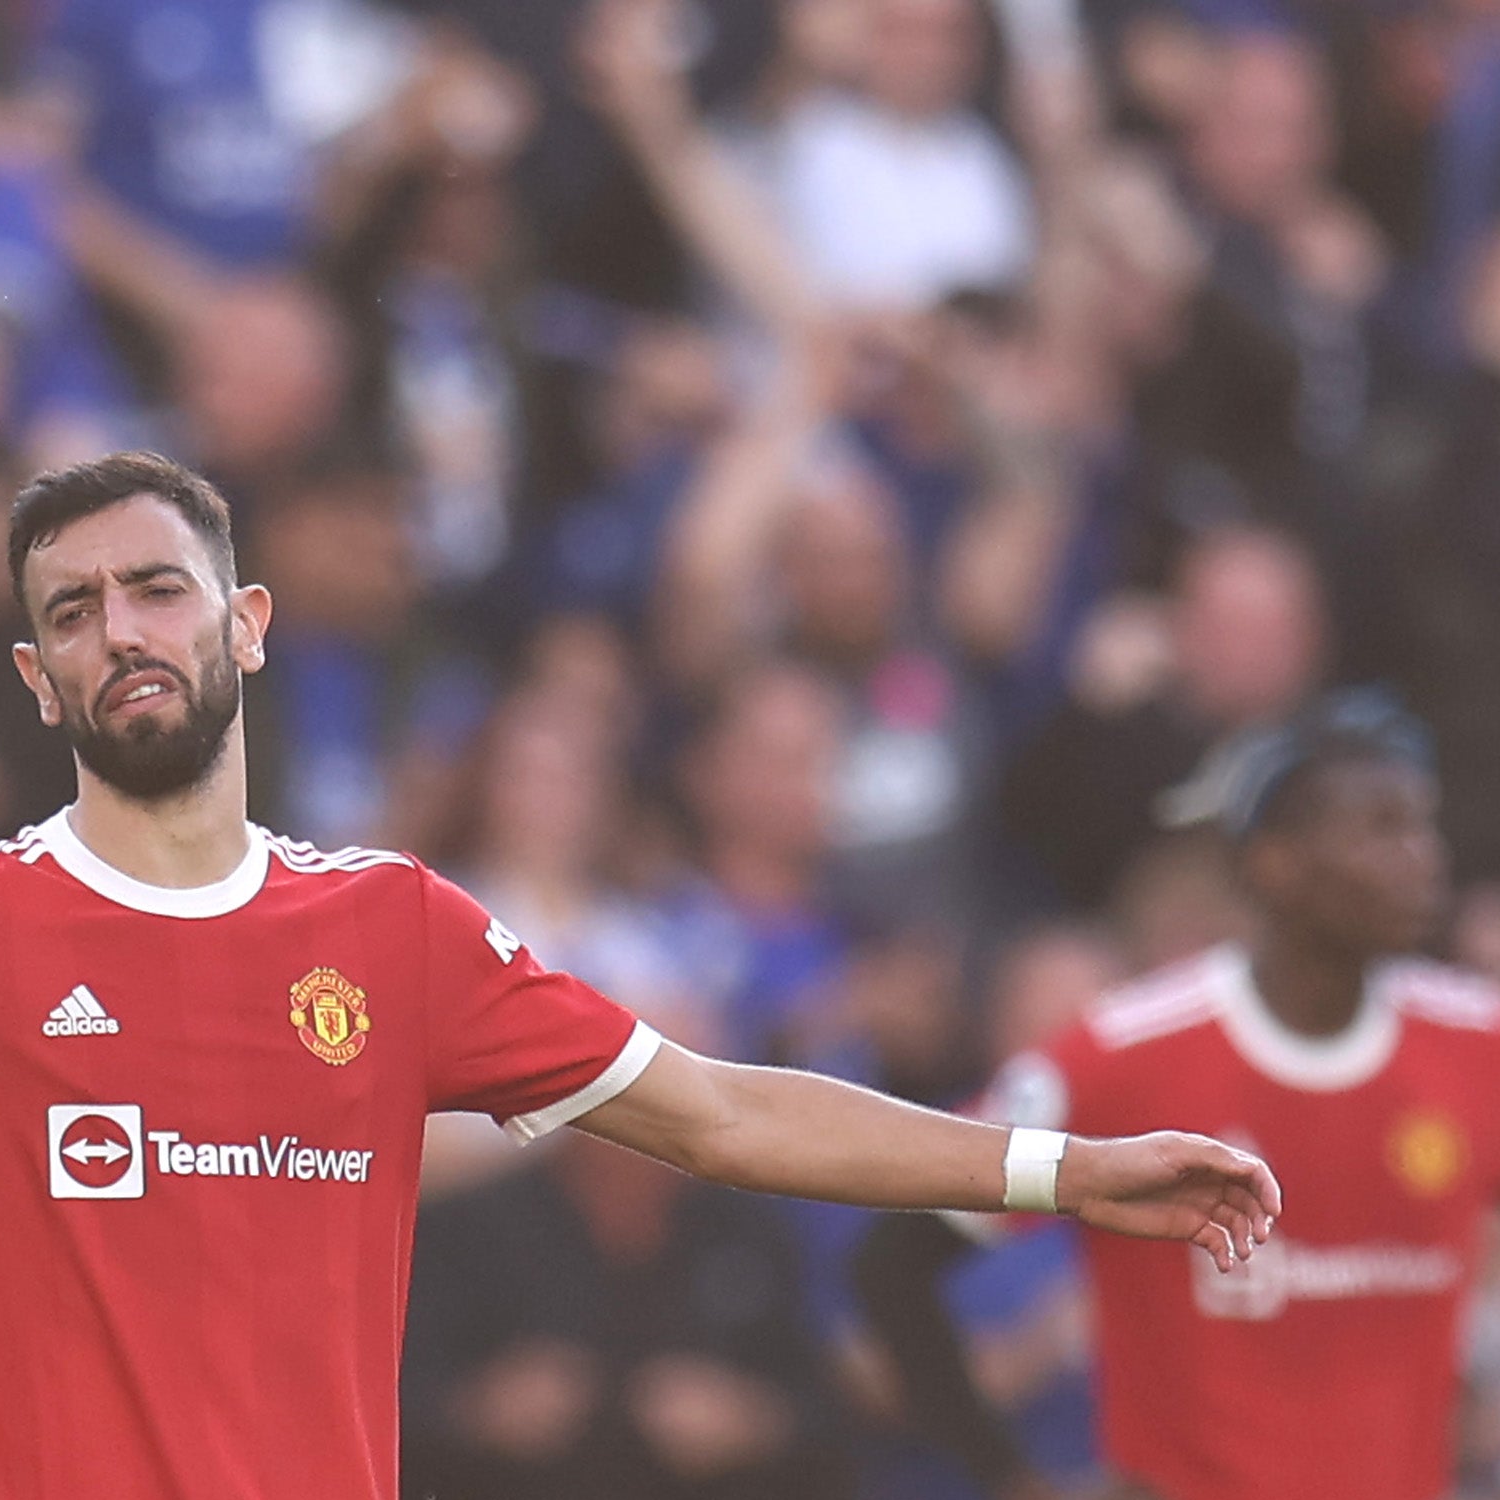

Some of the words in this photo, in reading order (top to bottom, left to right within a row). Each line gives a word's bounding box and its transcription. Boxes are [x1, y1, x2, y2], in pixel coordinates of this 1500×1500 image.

[42, 1016, 121, 1037] adidas
[312, 1040, 357, 1059] UNITED
[147, 1130, 374, 1183] TeamViewer
